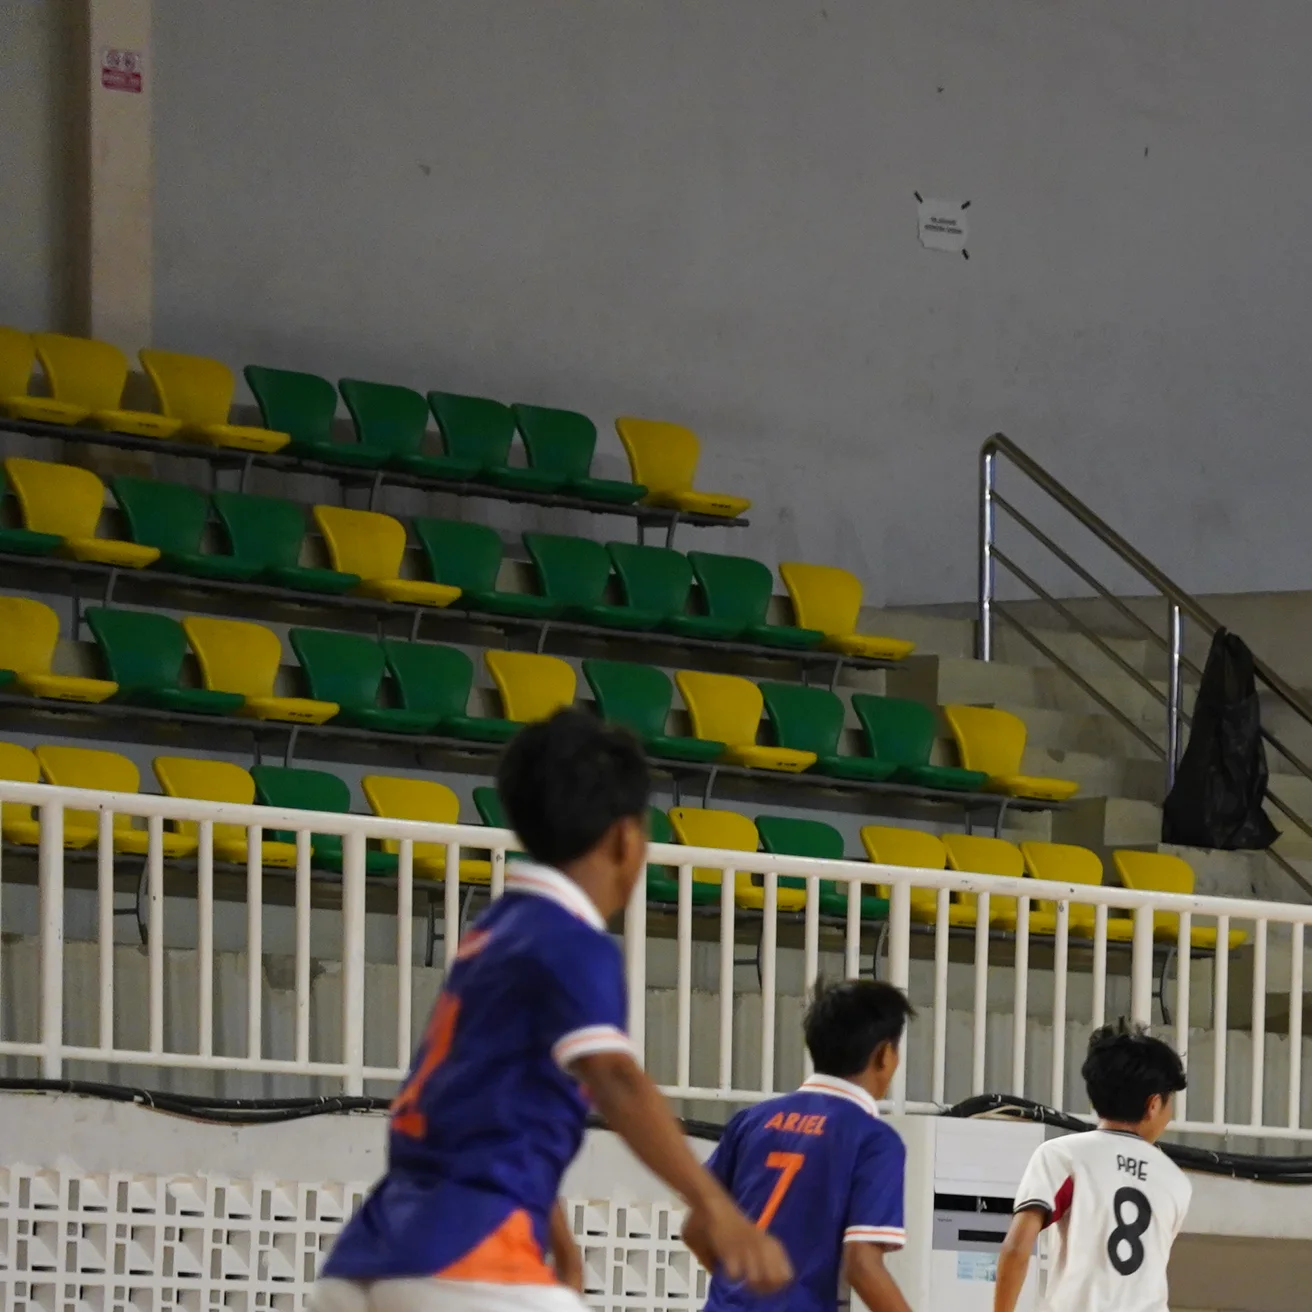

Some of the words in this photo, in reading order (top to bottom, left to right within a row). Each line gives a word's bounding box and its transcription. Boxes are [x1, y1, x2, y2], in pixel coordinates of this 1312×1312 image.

[764, 1111, 827, 1136] ARIEL
[756, 1151, 805, 1232] 7
[1107, 1186, 1152, 1276] 8
